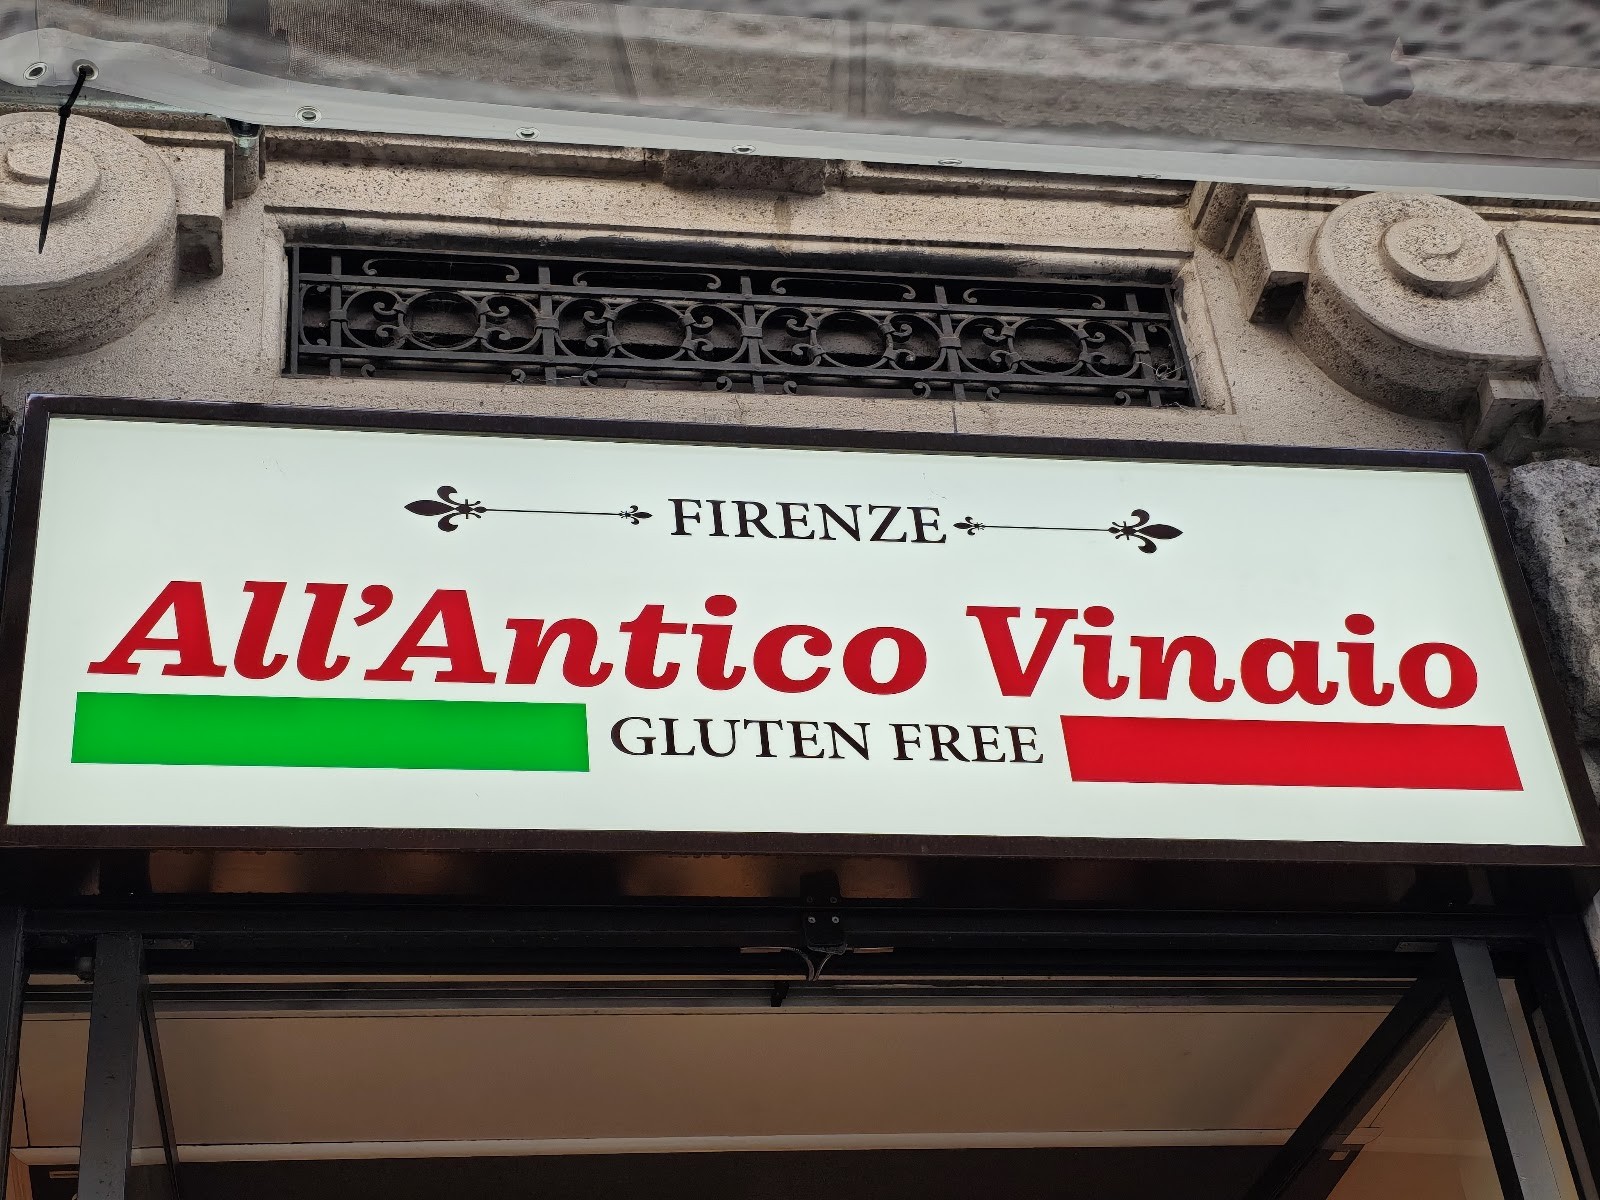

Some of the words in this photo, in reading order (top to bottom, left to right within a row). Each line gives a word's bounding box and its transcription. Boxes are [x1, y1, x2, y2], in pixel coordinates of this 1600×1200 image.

[667, 498, 947, 544] FIRENZE
[87, 580, 927, 695] All'Antico
[965, 605, 1478, 709] Vinaio
[610, 716, 871, 761] GLUTEN
[888, 723, 1044, 764] FREE
